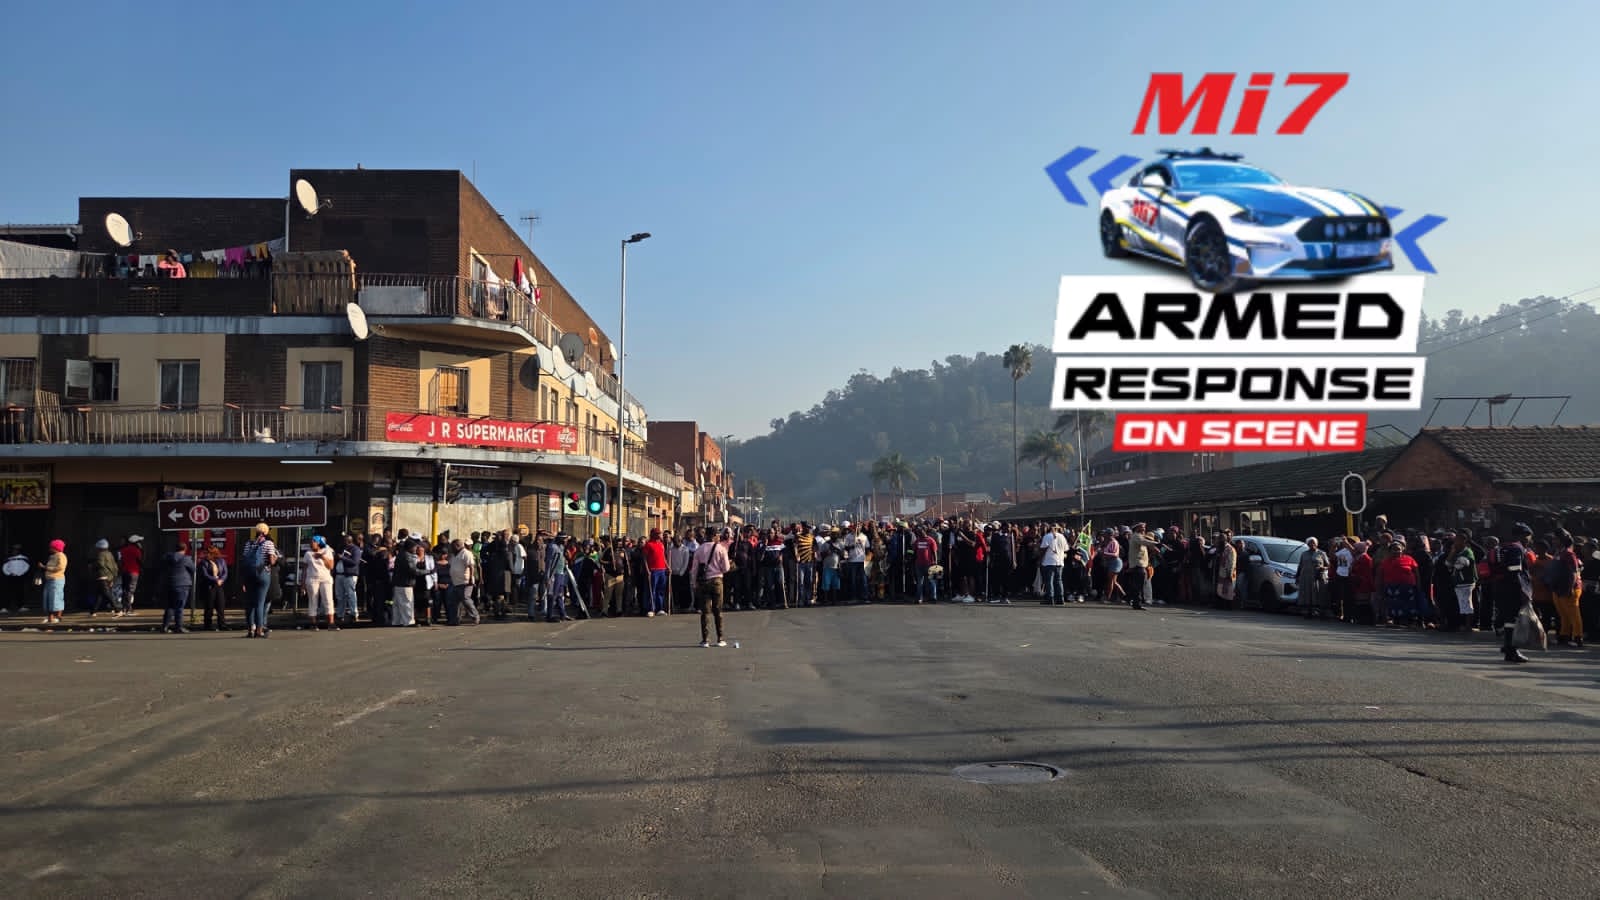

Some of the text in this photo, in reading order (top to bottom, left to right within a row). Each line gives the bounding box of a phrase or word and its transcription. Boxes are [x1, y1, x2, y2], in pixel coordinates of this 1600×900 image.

[428, 421, 546, 444] J R SUPERMARKET
[215, 506, 261, 519] Townhill
[265, 505, 310, 520] Hospital
